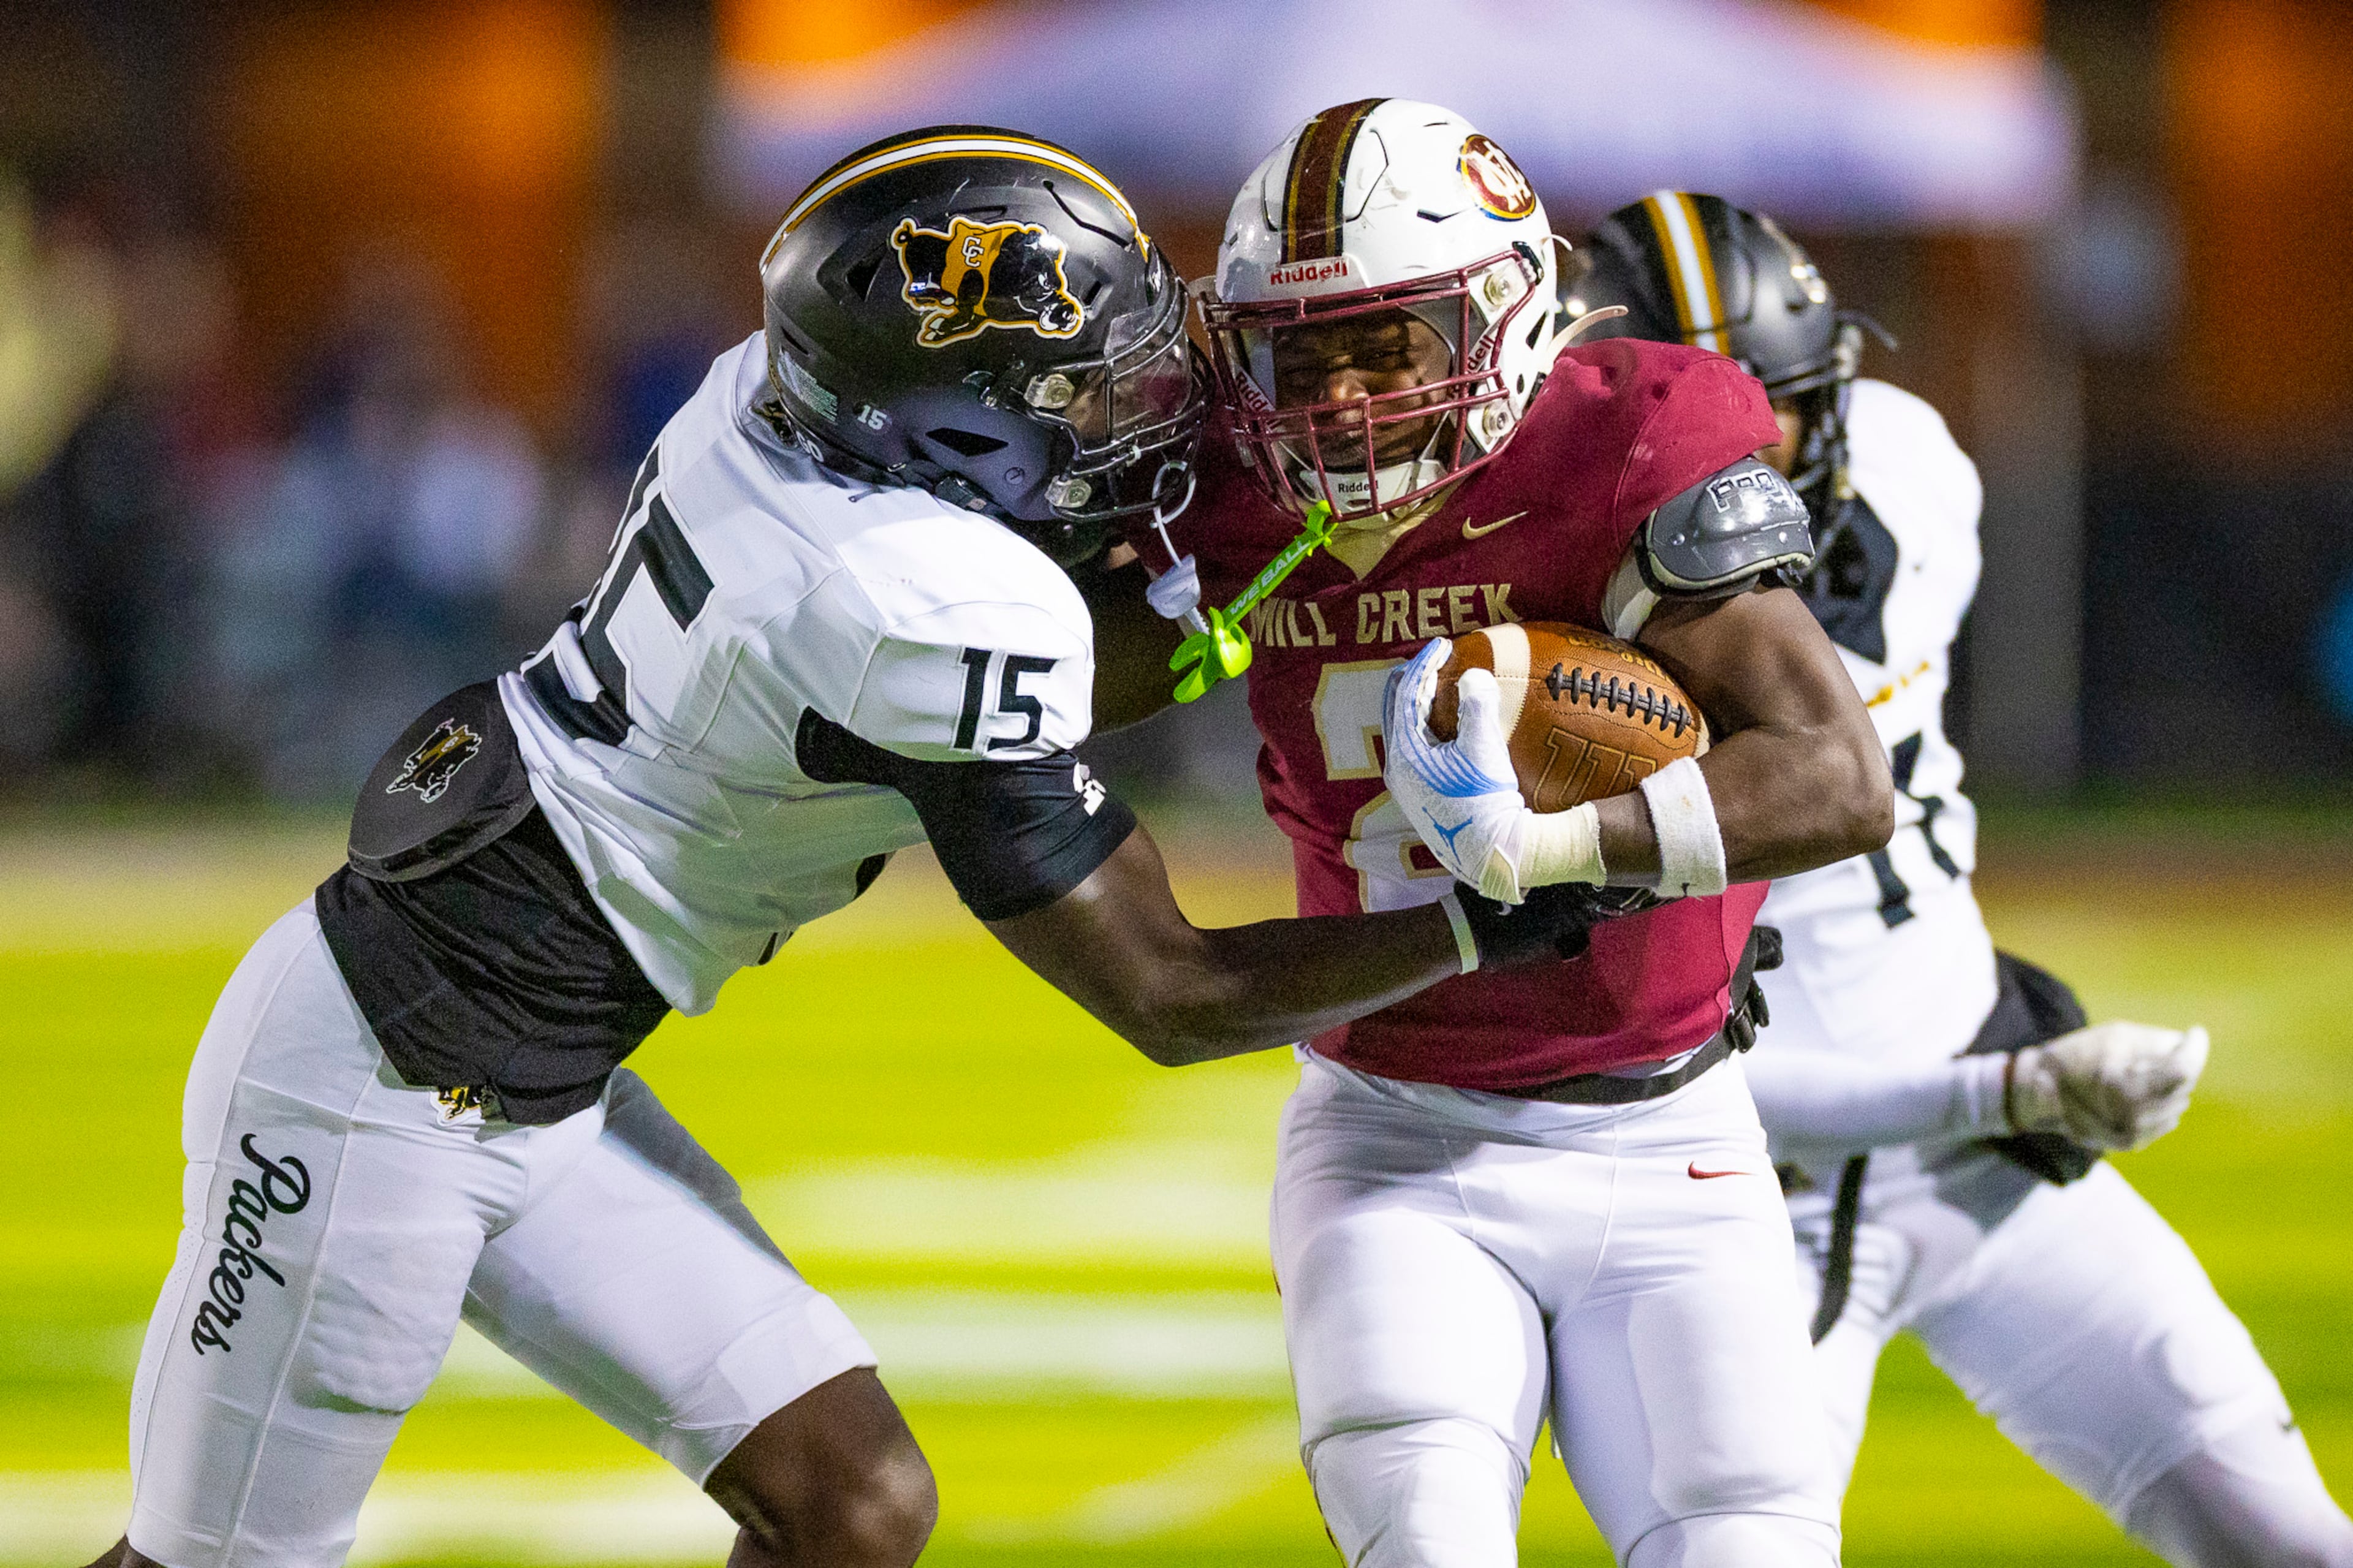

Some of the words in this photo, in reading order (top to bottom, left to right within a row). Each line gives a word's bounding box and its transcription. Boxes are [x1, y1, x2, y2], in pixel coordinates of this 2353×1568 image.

[1270, 261, 1348, 286] Riddell
[857, 404, 888, 430] 15
[1338, 479, 1379, 493] Riddel
[1230, 583, 1260, 615] WE
[1261, 540, 1311, 587] BALL
[1248, 597, 1336, 648] MILL
[1356, 583, 1523, 645] CREEK
[951, 646, 1060, 753] 15
[191, 1133, 311, 1355] Packers
